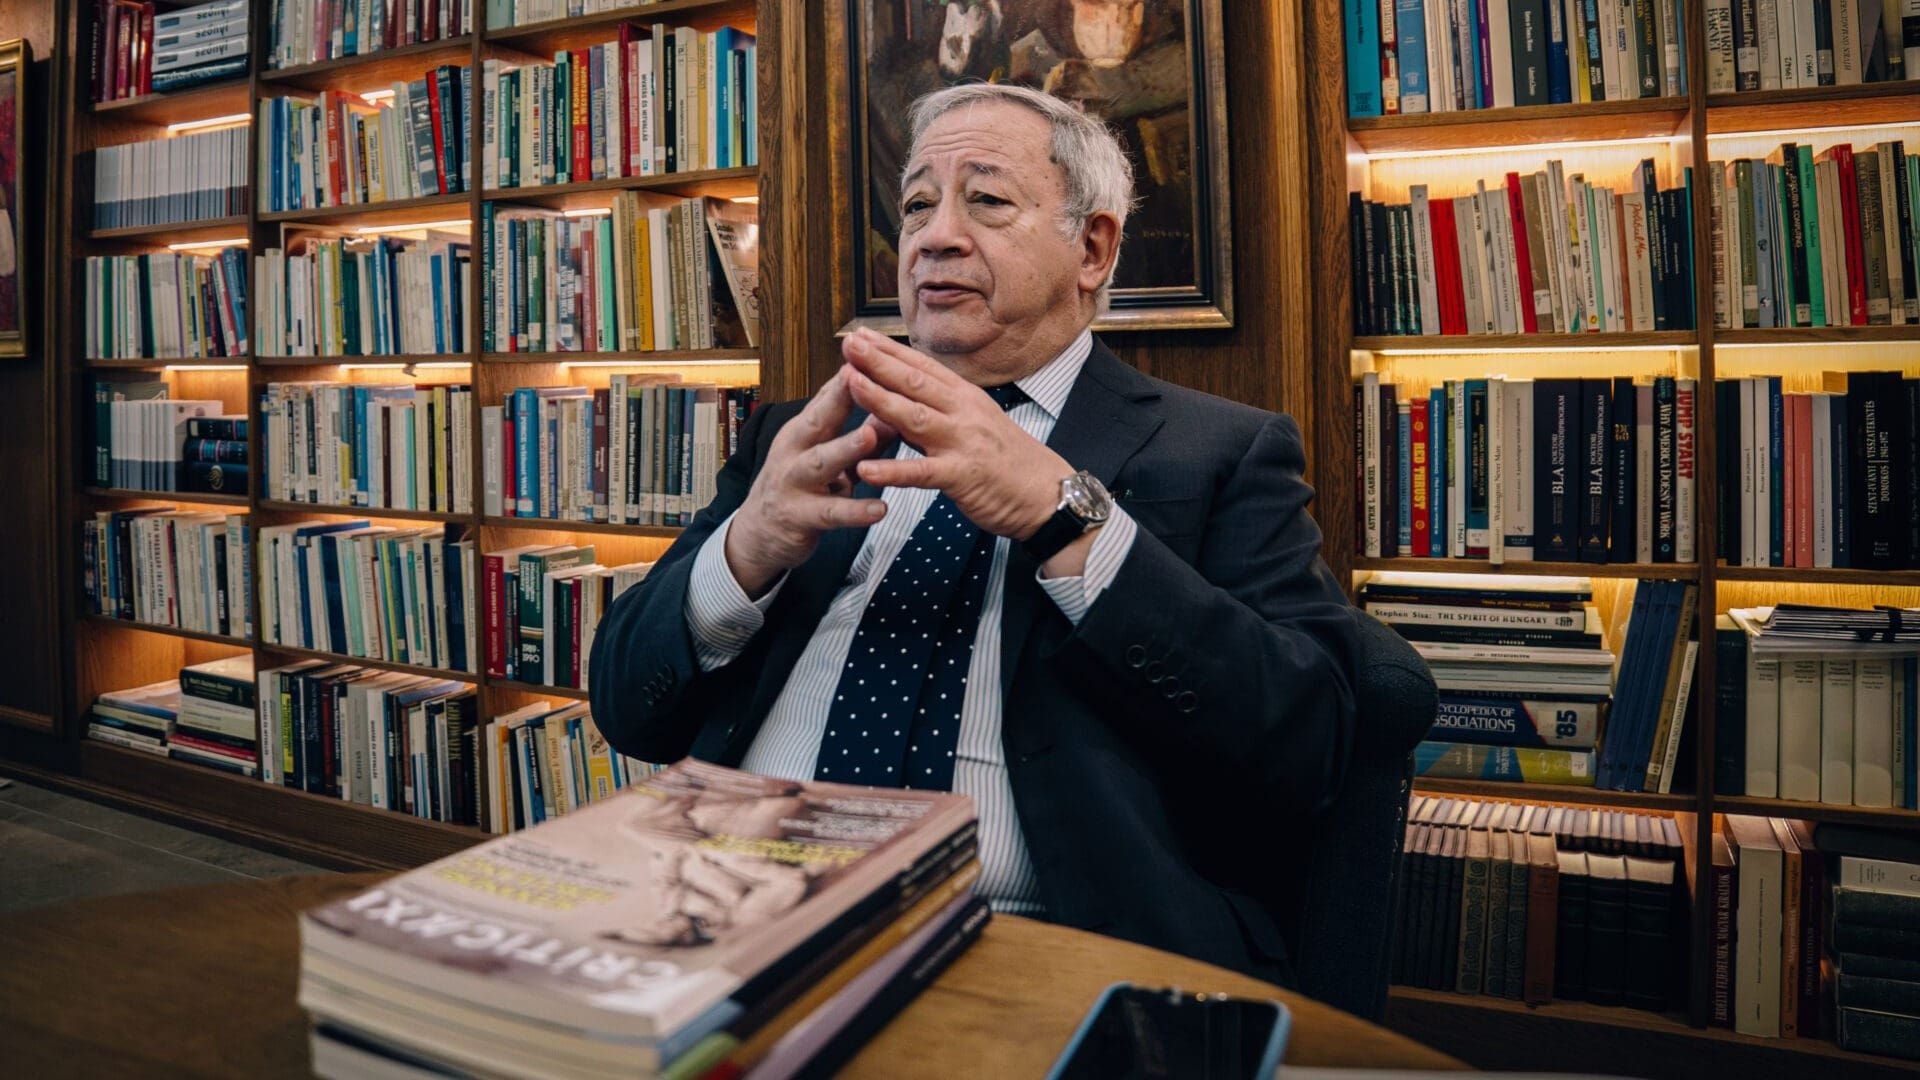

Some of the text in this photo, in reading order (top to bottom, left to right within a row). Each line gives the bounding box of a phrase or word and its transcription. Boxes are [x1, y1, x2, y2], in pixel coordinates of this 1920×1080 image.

[1708, 8, 1721, 51] BARNET
[1719, 8, 1733, 56] RICHARD
[1806, 55, 1814, 78] 1995/3
[547, 112, 555, 134] GOOD
[1631, 203, 1644, 241] Political
[520, 416, 529, 444] FORCE
[1678, 389, 1694, 480] JUMP START
[1864, 401, 1876, 458] VISSZATEKINTÉS
[1368, 465, 1376, 495] GABRIEL
[1413, 442, 1426, 510] RED THRUST
[1552, 467, 1564, 495] BLA
[1590, 467, 1603, 495] BLA
[1659, 403, 1672, 539] WHY AMERICA DOESN'T WORK
[1880, 465, 1890, 502] DOMOKOS
[1494, 483, 1502, 522] Washington
[1866, 465, 1878, 514] SZENT-IVÁNYI
[1368, 505, 1376, 531] ASTRIK
[1375, 609, 1547, 625] Stephen Sisa: THE SPIRIT OF HUNGARY
[1432, 715, 1515, 732] SSOCIATIONS
[1439, 704, 1514, 718] YCLOPEDIA OF
[1715, 874, 1730, 909] KIRÁLYOK
[1716, 912, 1729, 940] MAGYAR
[1715, 992, 1728, 1021] ERDÉLYI
